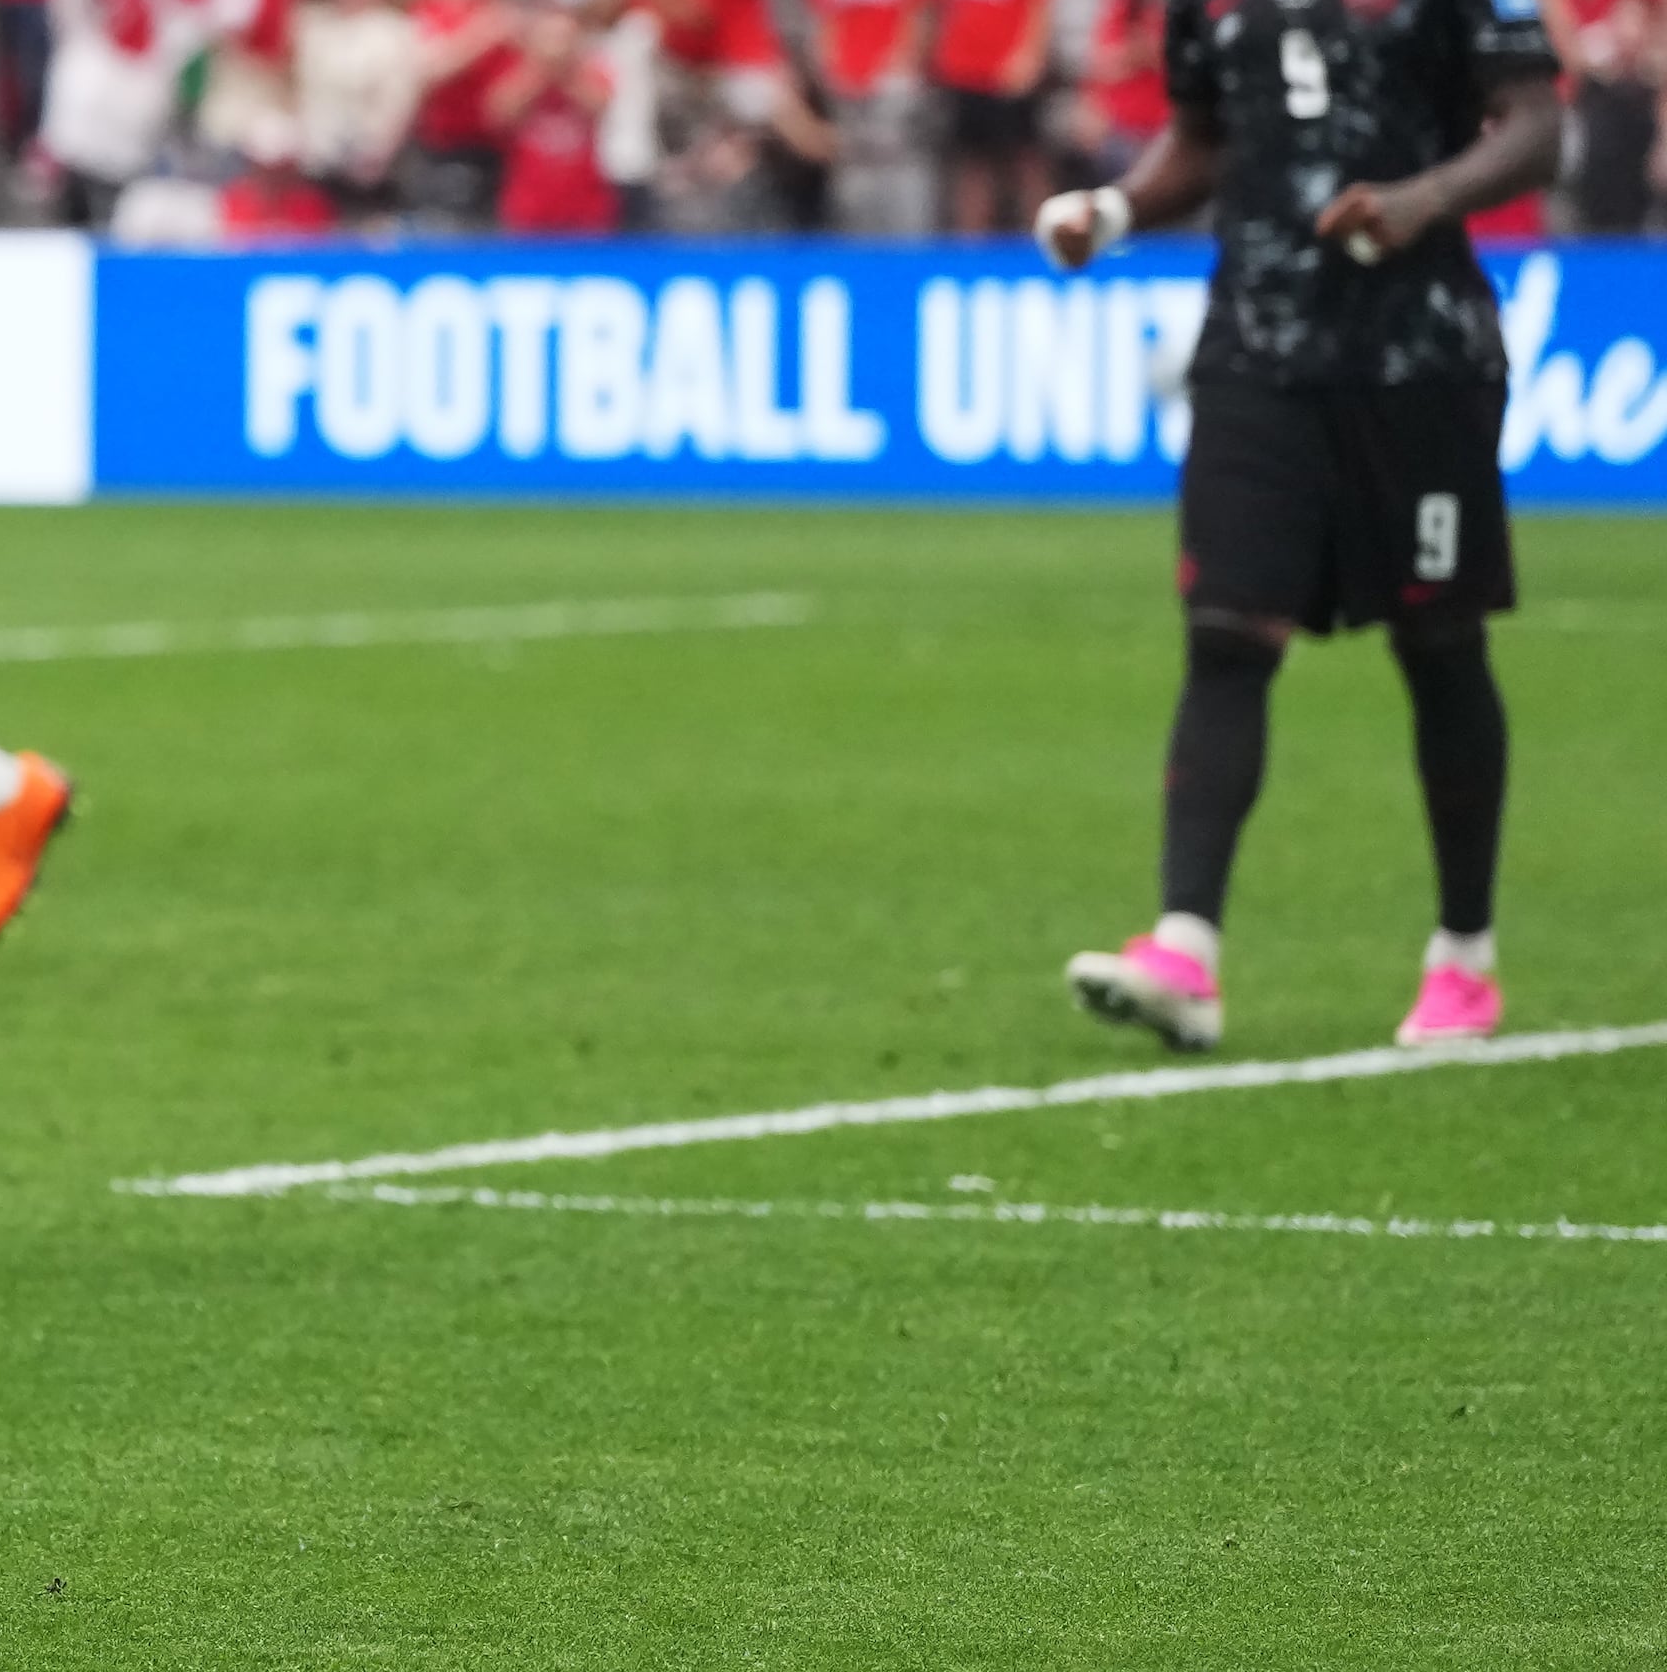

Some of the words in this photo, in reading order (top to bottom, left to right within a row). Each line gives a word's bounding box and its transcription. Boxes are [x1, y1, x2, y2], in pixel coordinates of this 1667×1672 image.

[244, 274, 888, 462] FOOTBALL
[917, 274, 1210, 464] UNIT
[1415, 491, 1461, 582] 9
